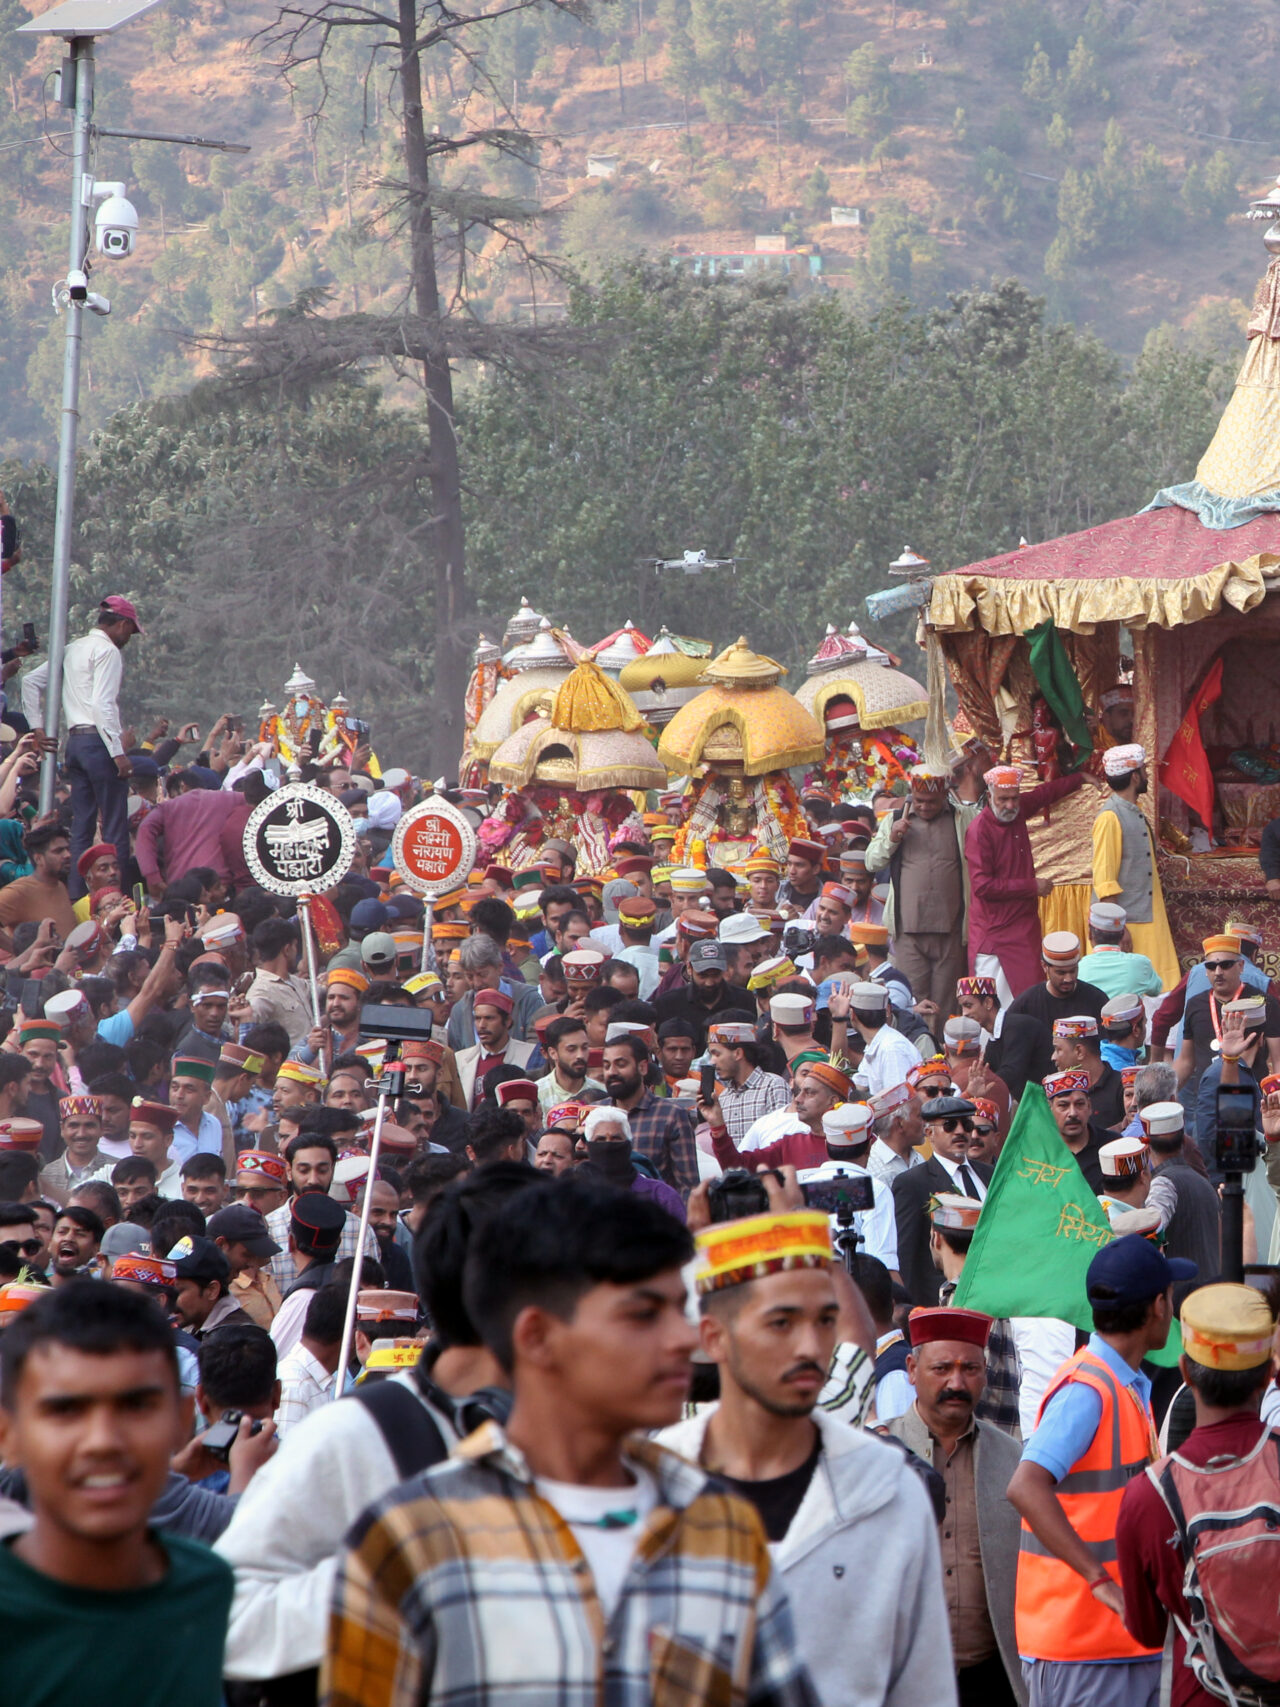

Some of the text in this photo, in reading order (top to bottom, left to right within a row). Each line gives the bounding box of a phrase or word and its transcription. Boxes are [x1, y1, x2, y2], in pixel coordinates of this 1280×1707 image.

[285, 797, 304, 817] श्री
[425, 817, 440, 832] श्री
[1016, 1157, 1072, 1188] जय
[1056, 1202, 1115, 1248] सिया
